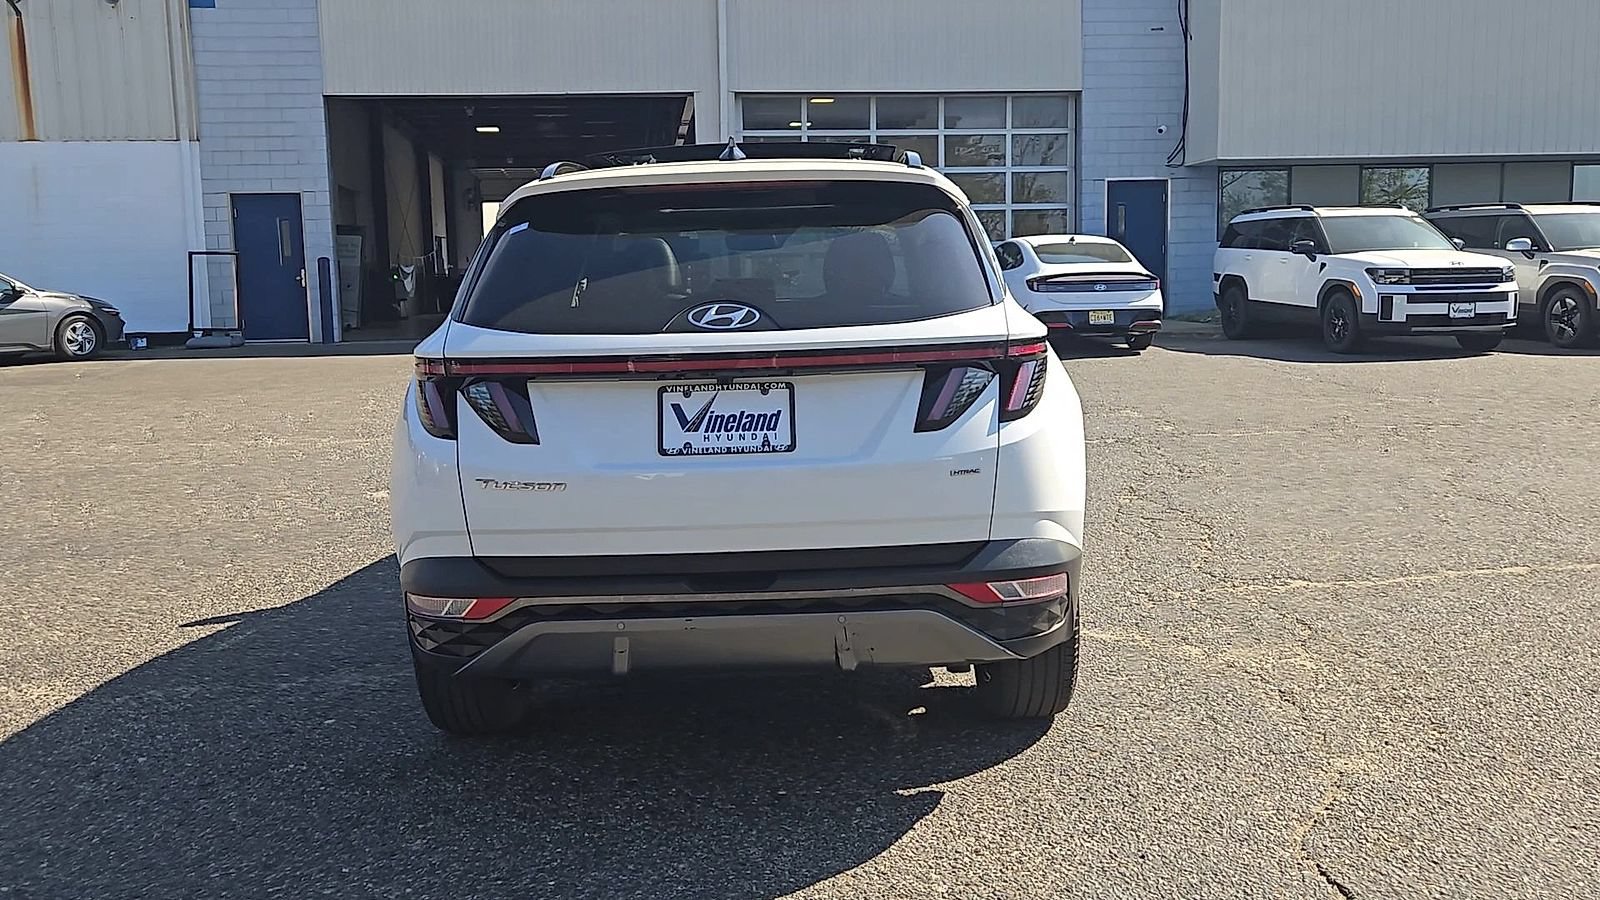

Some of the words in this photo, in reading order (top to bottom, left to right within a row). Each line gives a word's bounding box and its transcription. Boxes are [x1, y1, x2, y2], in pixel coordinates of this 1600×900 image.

[666, 382, 786, 393] VINELANDHYUNDAI.COM
[670, 391, 782, 433] Vineland
[703, 433, 777, 442] HYUNDAI
[682, 446, 727, 455] VINELAND
[730, 444, 773, 453] HYUNDAI
